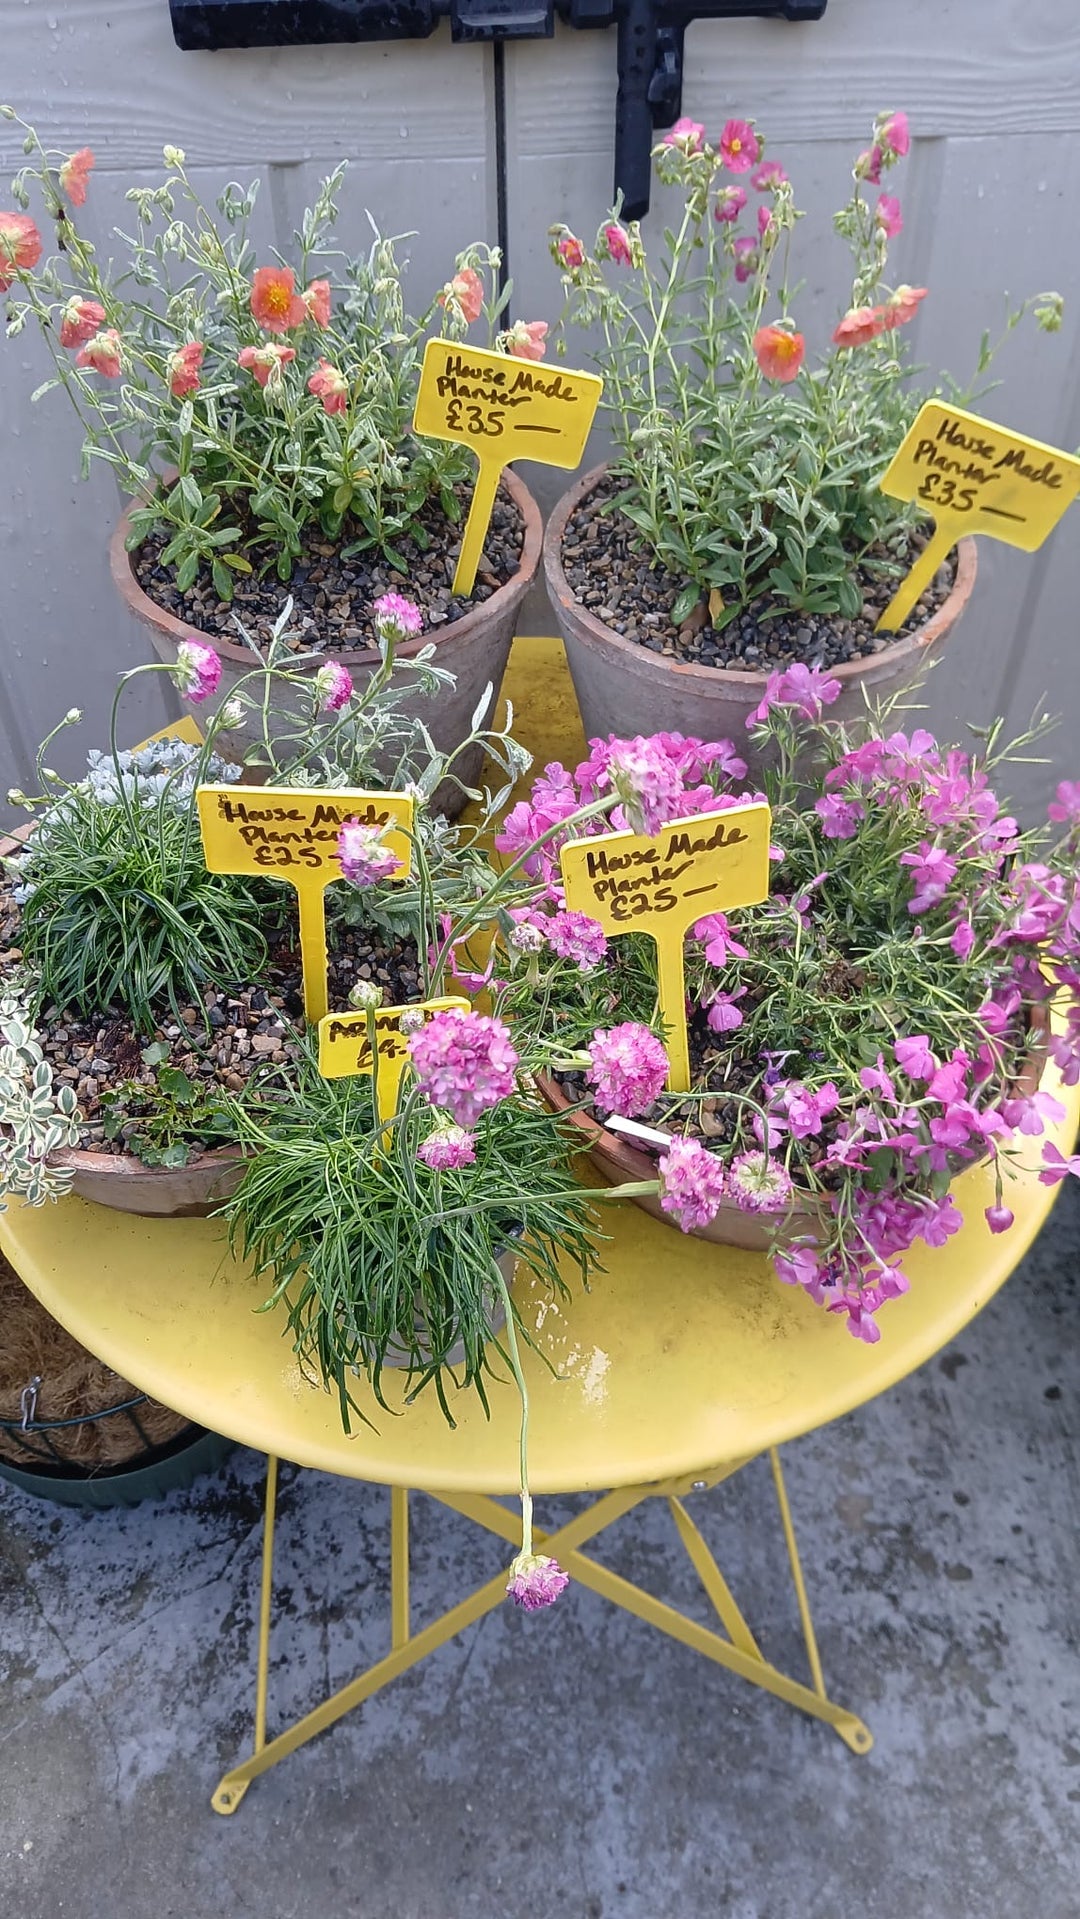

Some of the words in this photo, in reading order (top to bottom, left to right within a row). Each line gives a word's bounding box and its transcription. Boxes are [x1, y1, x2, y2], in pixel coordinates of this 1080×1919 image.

[436, 375, 532, 407] Planter
[446, 356, 506, 387] House
[509, 371, 578, 402] Made
[913, 439, 1001, 485] Planter
[936, 418, 996, 460] House
[993, 449, 1063, 490] Made
[223, 801, 306, 823] House
[586, 848, 660, 878] House
[664, 824, 748, 862] Made
[593, 860, 695, 901] Planter
